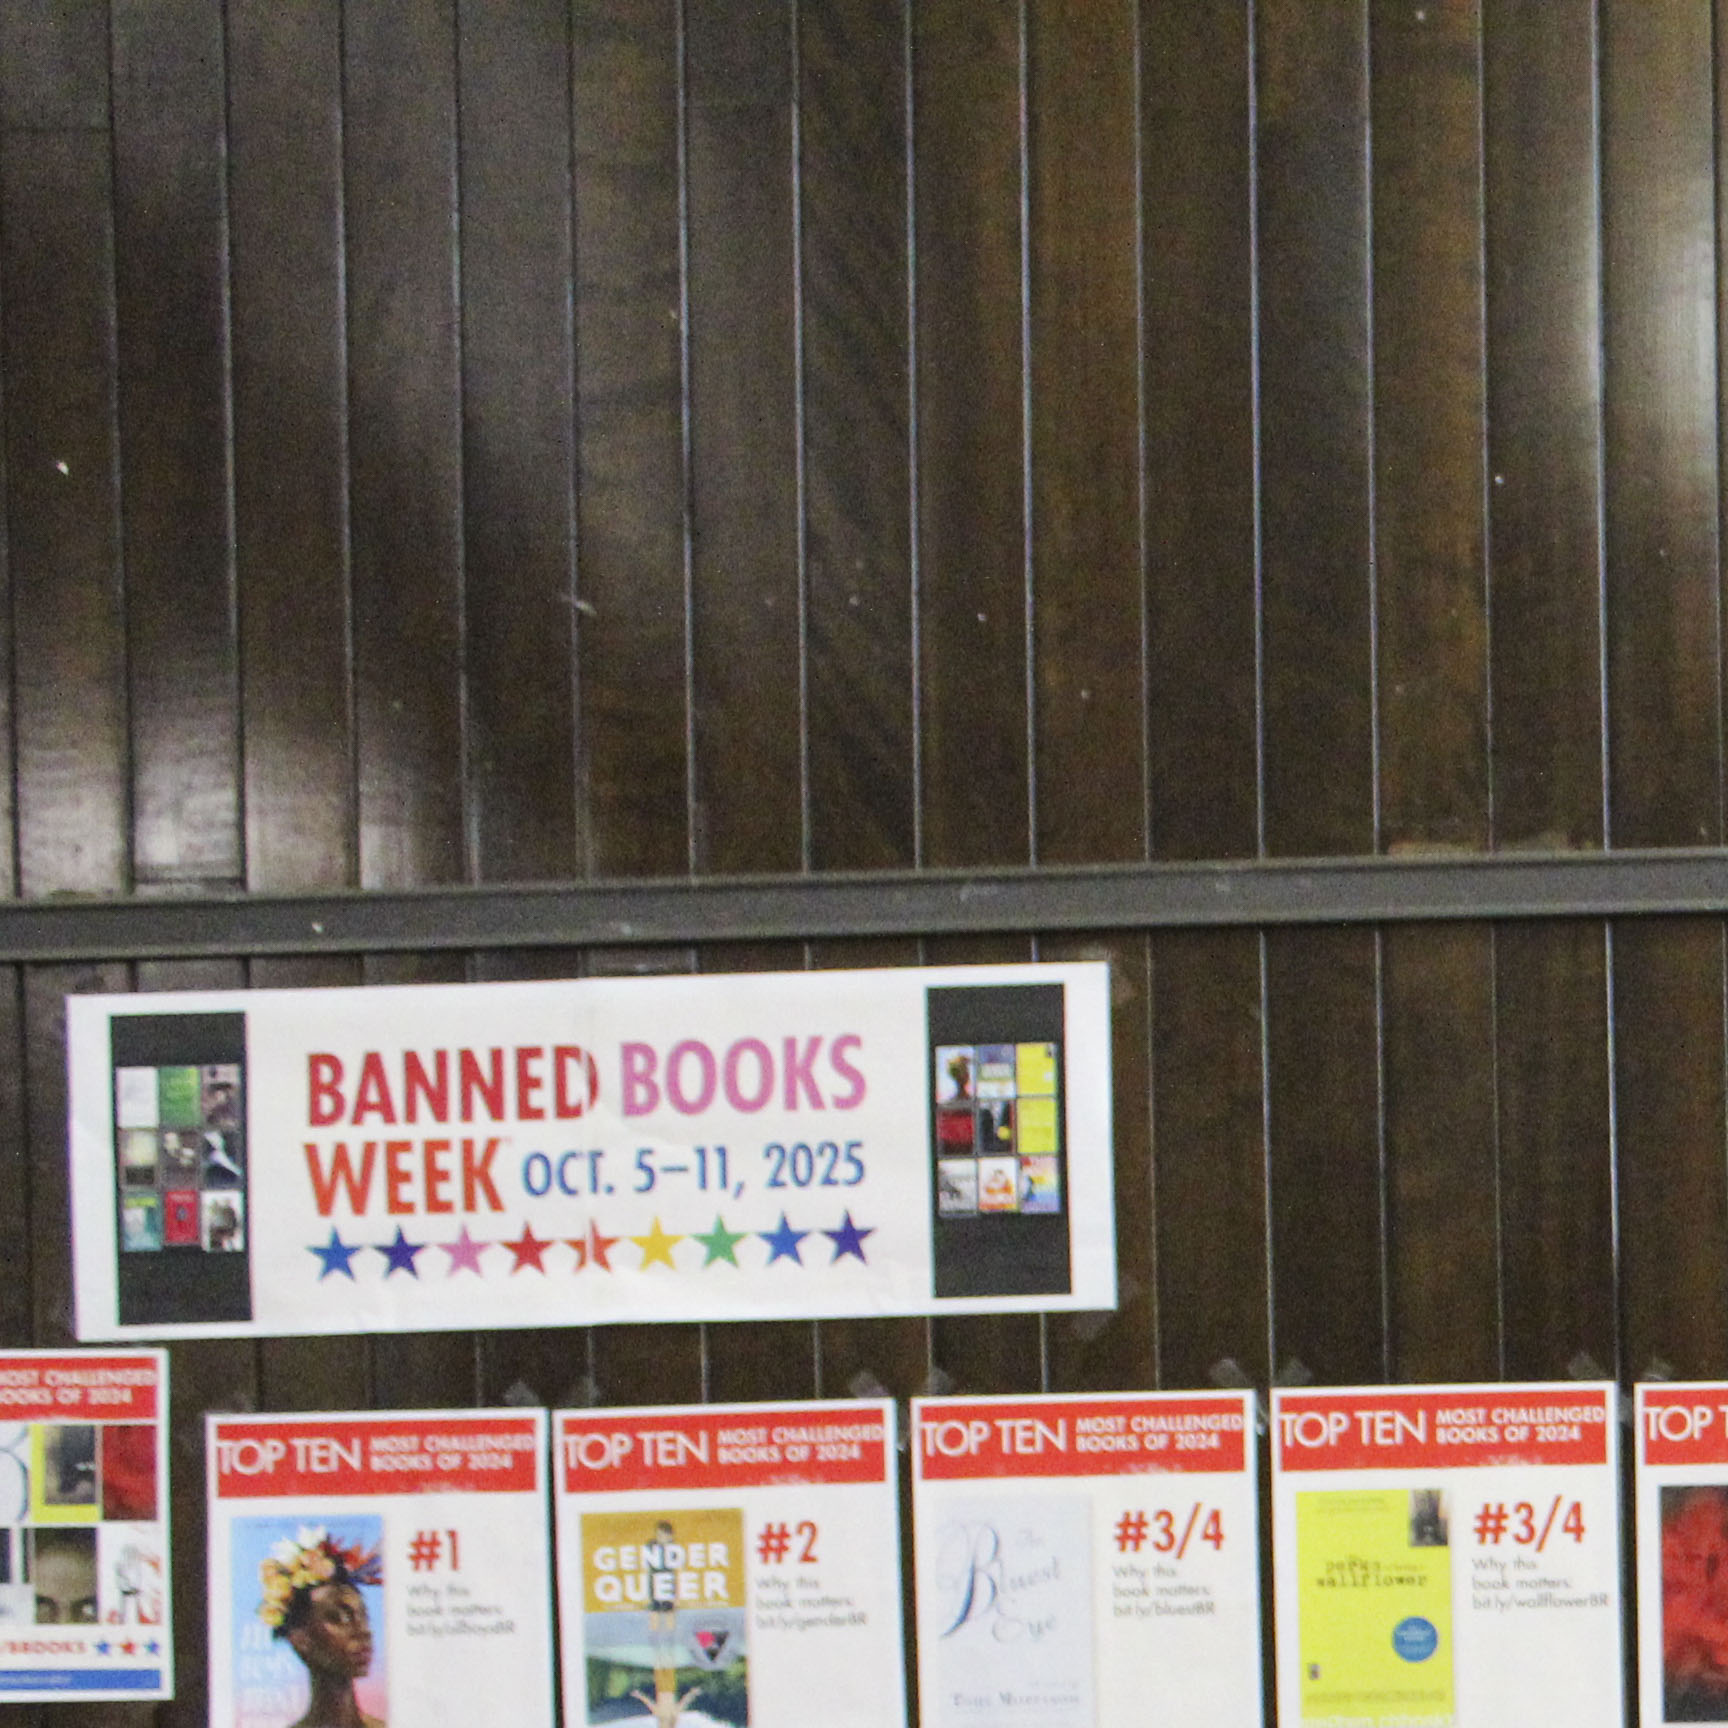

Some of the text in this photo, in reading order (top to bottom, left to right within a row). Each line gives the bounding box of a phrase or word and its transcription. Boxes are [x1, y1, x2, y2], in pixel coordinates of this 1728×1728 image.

[307, 1033, 868, 1128] BANNED BOOKS
[303, 1136, 508, 1216] WEEK
[522, 1149, 614, 1198] OCT.
[764, 1139, 866, 1190] 2025
[920, 1418, 1067, 1457] TOP TEN
[1279, 1410, 1427, 1447] TOP TEN
[1643, 1405, 1713, 1441] TOP
[562, 1430, 709, 1470] TOP TEN
[758, 1520, 819, 1564] #2
[1114, 1502, 1225, 1560] #3/4
[1474, 1494, 1585, 1553] #3/4
[409, 1530, 460, 1571] #1
[594, 1542, 729, 1571] GENDER
[594, 1571, 729, 1601] QUEER
[1316, 1573, 1428, 1588] wallflower
